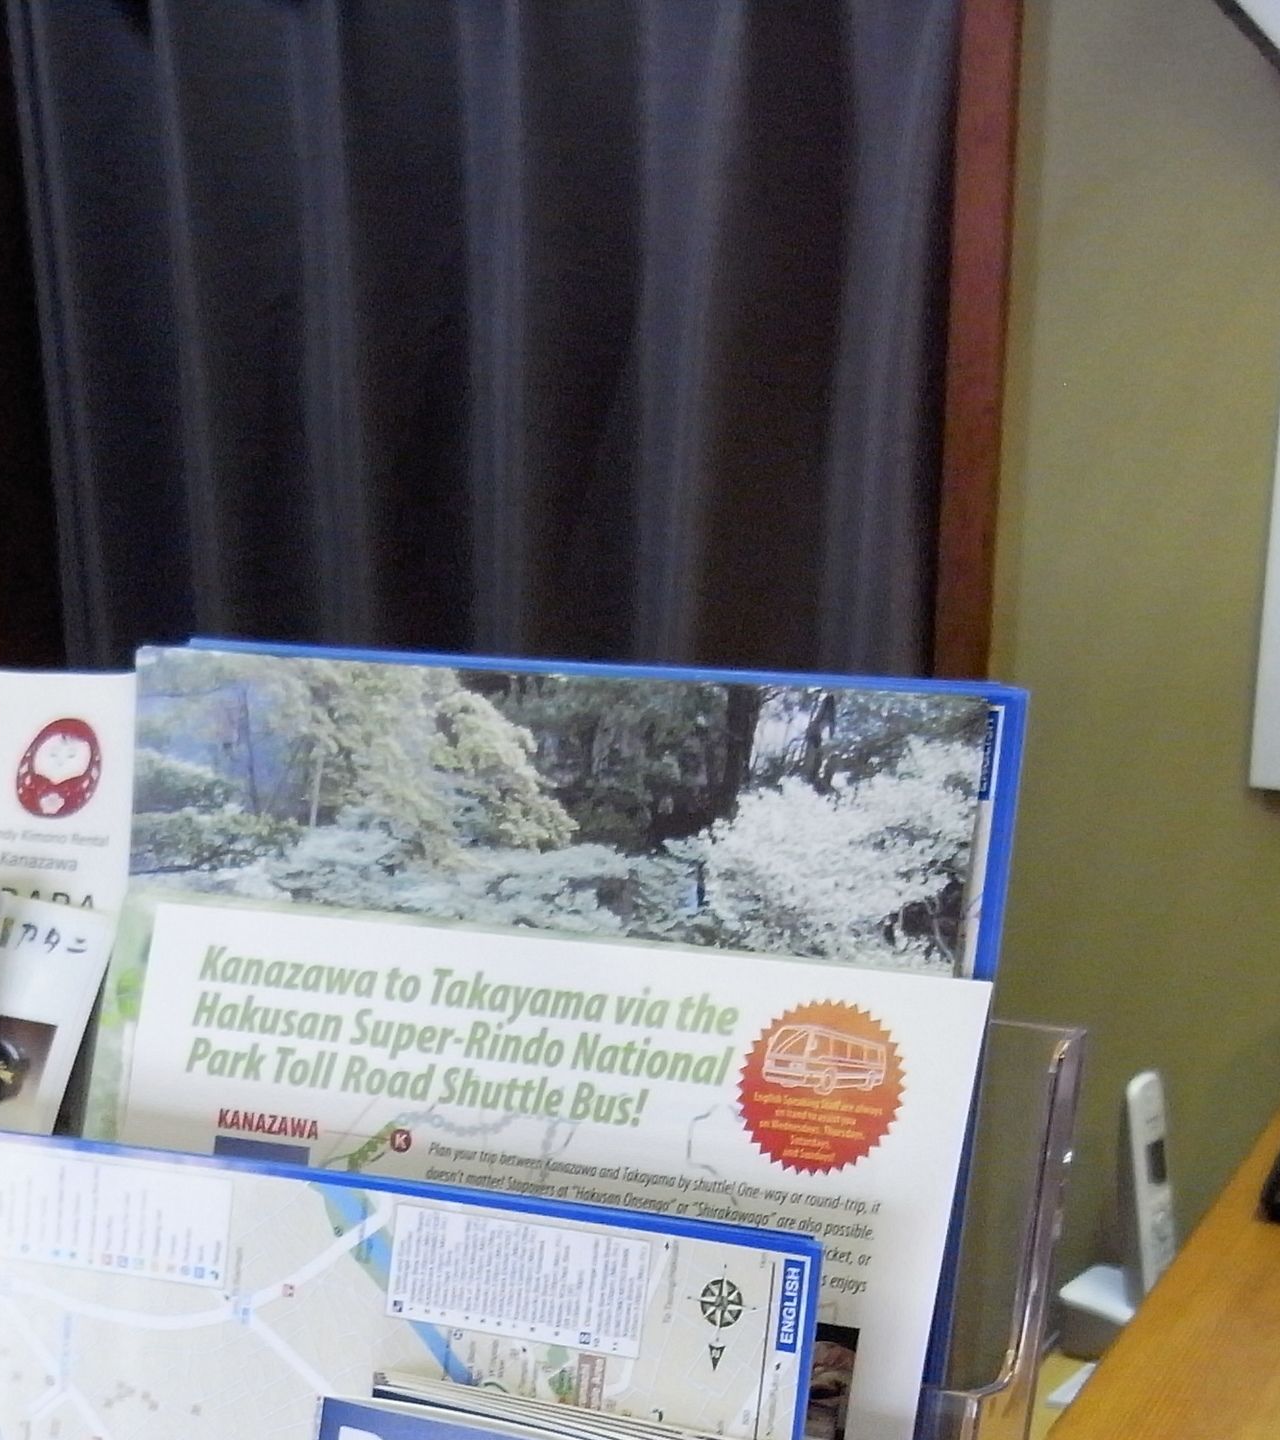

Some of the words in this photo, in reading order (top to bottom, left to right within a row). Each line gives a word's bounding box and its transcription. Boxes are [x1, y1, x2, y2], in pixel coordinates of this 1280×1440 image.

[198, 943, 378, 998] Kanazawa
[384, 967, 421, 1003] to
[431, 967, 608, 1025] Takayama
[615, 985, 671, 1030] via
[676, 992, 740, 1037] the
[191, 990, 343, 1043] Hakusan
[349, 1007, 565, 1069] Super-Rindo
[570, 1031, 737, 1087] National
[185, 1036, 268, 1082] Park
[274, 1046, 338, 1090] Toll
[340, 1055, 436, 1102] Road
[438, 1066, 565, 1118] Shuttle
[570, 1081, 651, 1128] Bus!
[217, 1107, 320, 1141] KANAZAWA
[544, 1158, 598, 1178] Kanazawa
[599, 1166, 621, 1180] and
[622, 1167, 676, 1189] Takayama
[678, 1175, 691, 1192] by
[779, 1266, 802, 1345] ENGLISH
